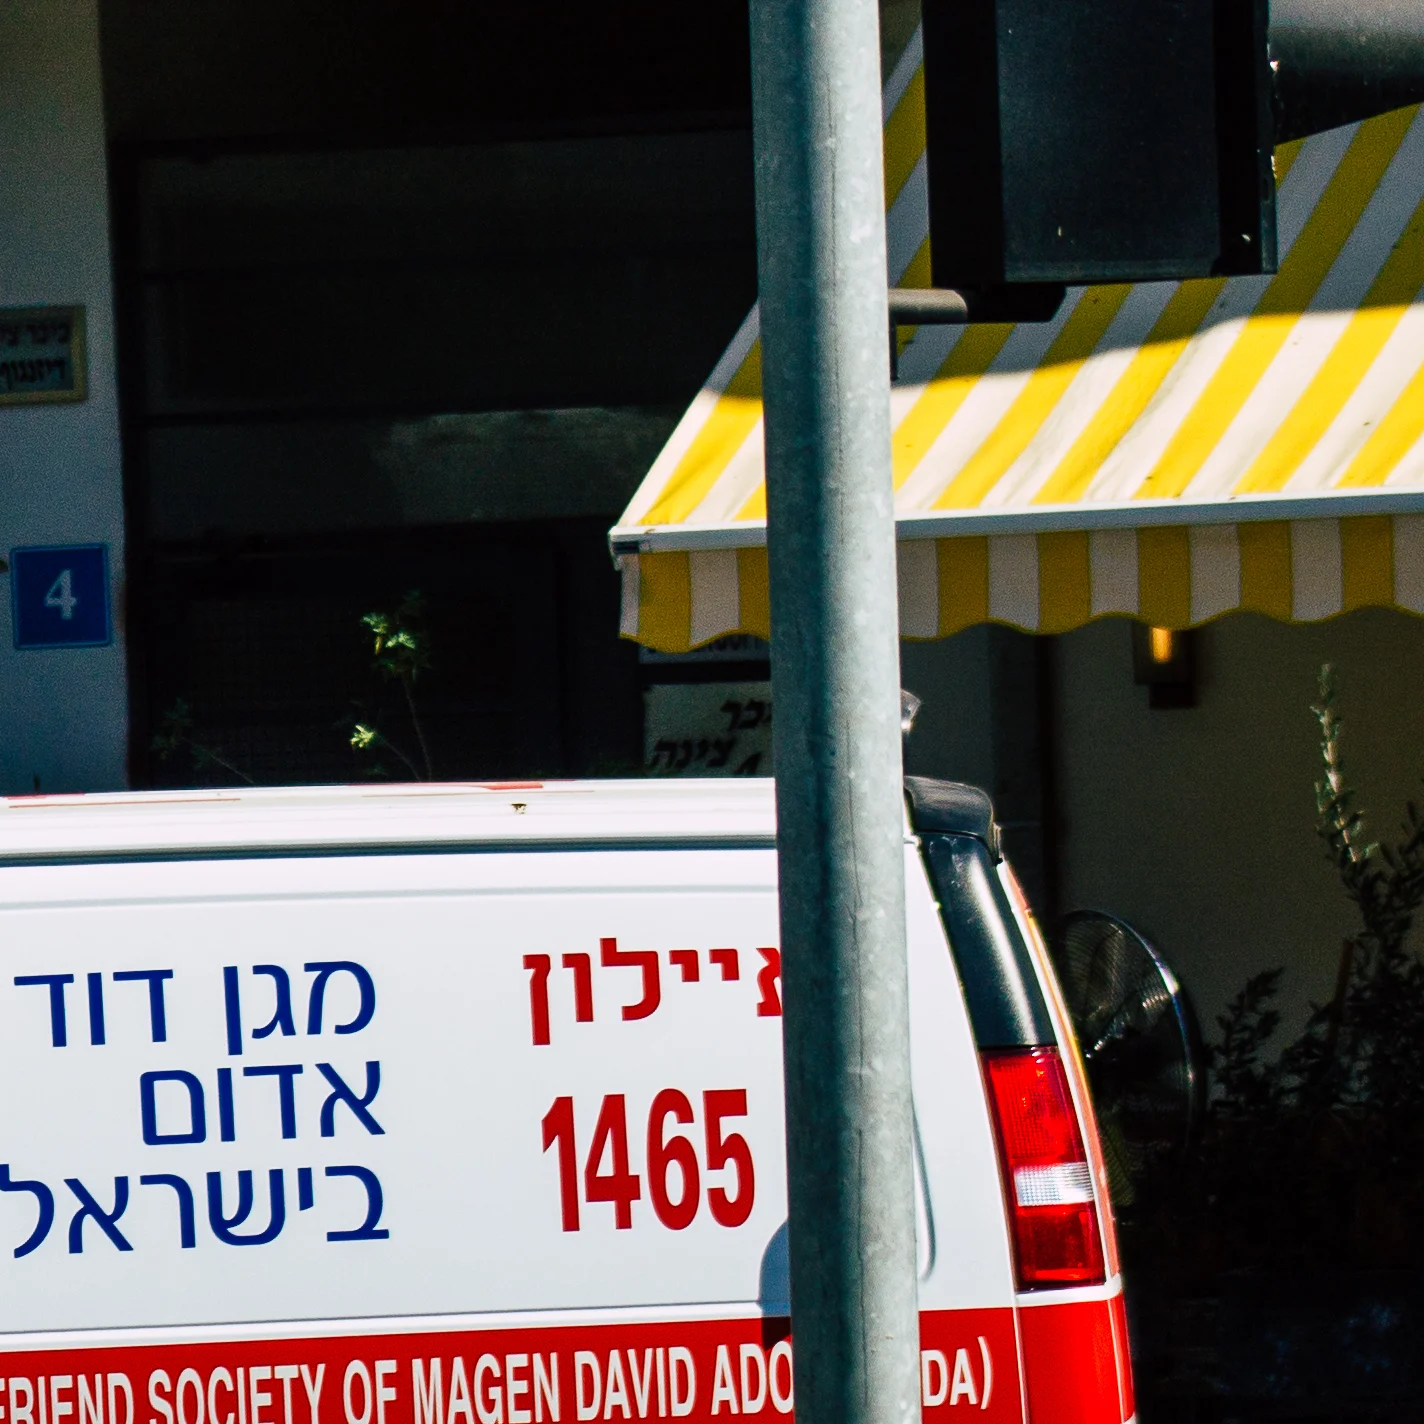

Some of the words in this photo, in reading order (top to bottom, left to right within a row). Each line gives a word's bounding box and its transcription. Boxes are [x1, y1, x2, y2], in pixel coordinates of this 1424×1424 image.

[44, 569, 77, 621] 4
[13, 969, 174, 1048] דוד
[223, 960, 376, 1056] מגן
[139, 1060, 386, 1146] אדום
[541, 1088, 755, 1232] 1465
[574, 1346, 696, 1421] DAVID
[710, 1340, 793, 1416] ADO
[920, 1335, 992, 1410] DA)
